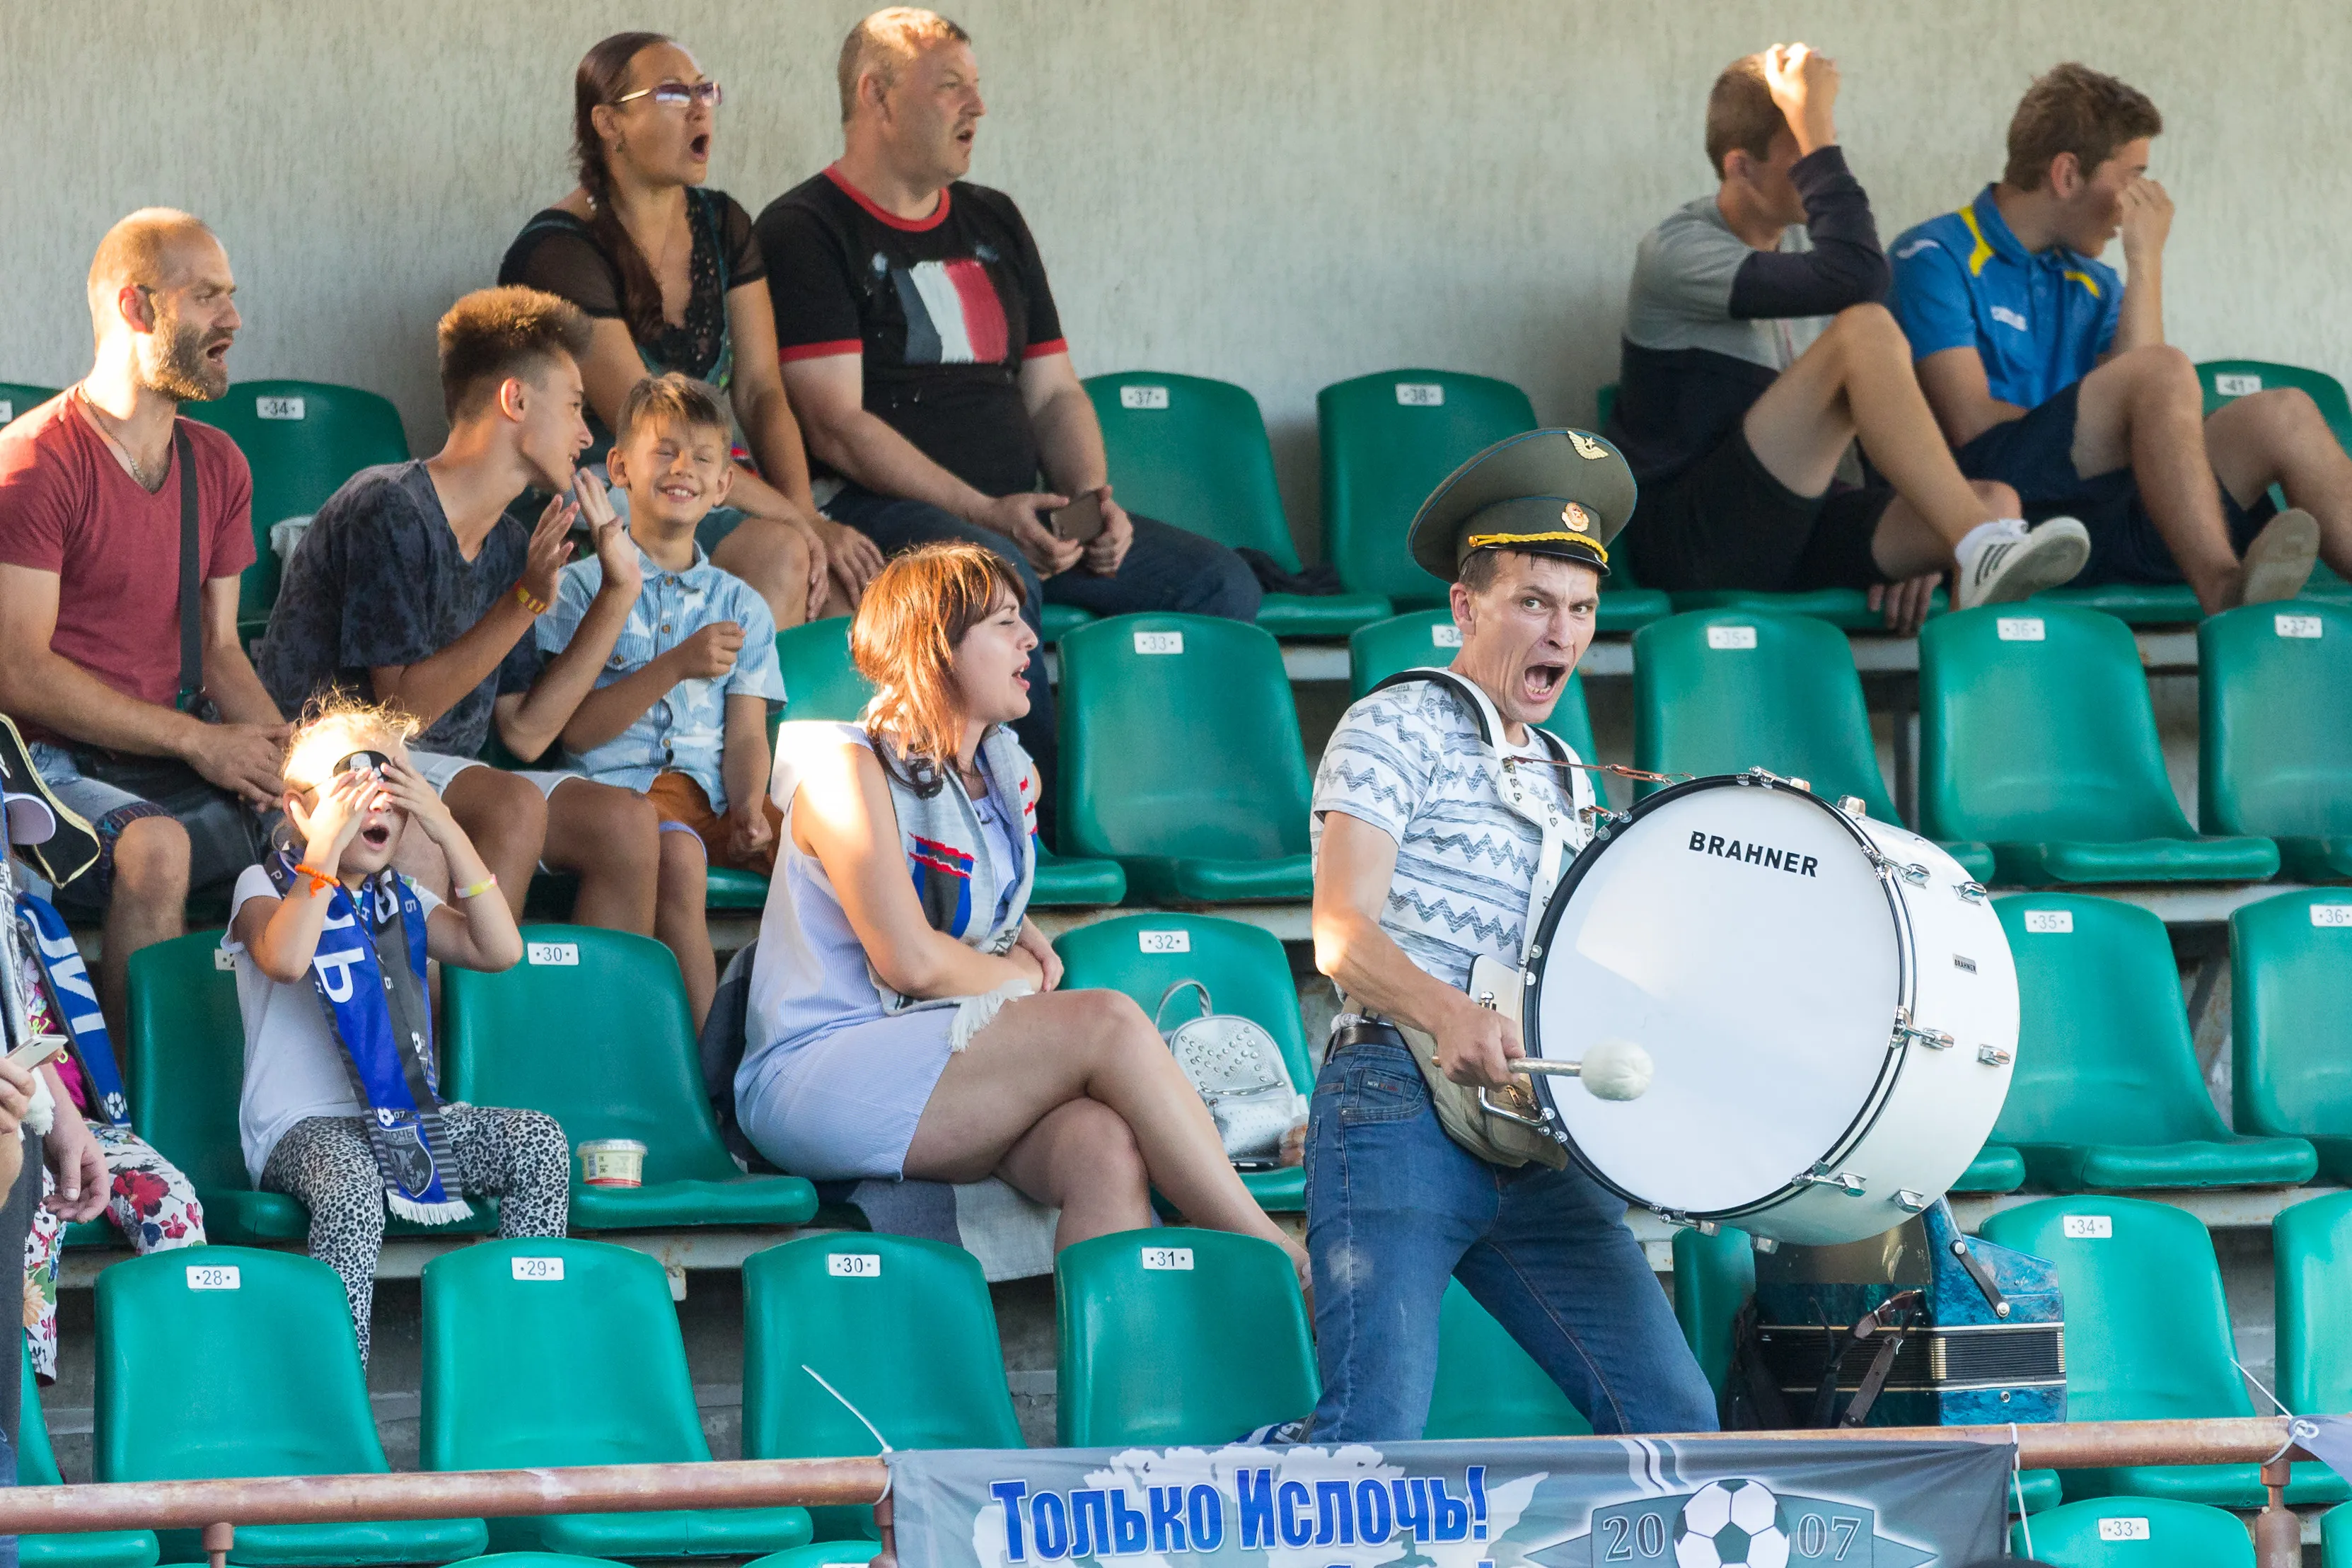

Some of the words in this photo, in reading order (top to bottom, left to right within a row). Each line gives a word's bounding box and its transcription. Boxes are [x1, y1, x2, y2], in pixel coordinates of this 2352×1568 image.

[1149, 636, 1166, 651] 33
[1689, 831, 1819, 878] BRAHNER
[2039, 914, 2056, 929] 35
[2326, 909, 2344, 924] 36
[1154, 935, 1175, 949] 32
[543, 947, 562, 962] 30
[1954, 958, 1976, 972] BRAHNER
[2077, 1219, 2095, 1234] 34
[843, 1258, 863, 1273] 30
[1157, 1251, 1175, 1267] 31
[526, 1261, 545, 1276] 29
[202, 1270, 222, 1285] 28
[990, 1480, 1226, 1562] Только
[1235, 1465, 1491, 1550] Ислочь!
[2114, 1521, 2133, 1537] 33
[1602, 1512, 1664, 1562] 20
[1797, 1512, 1862, 1562] 07
